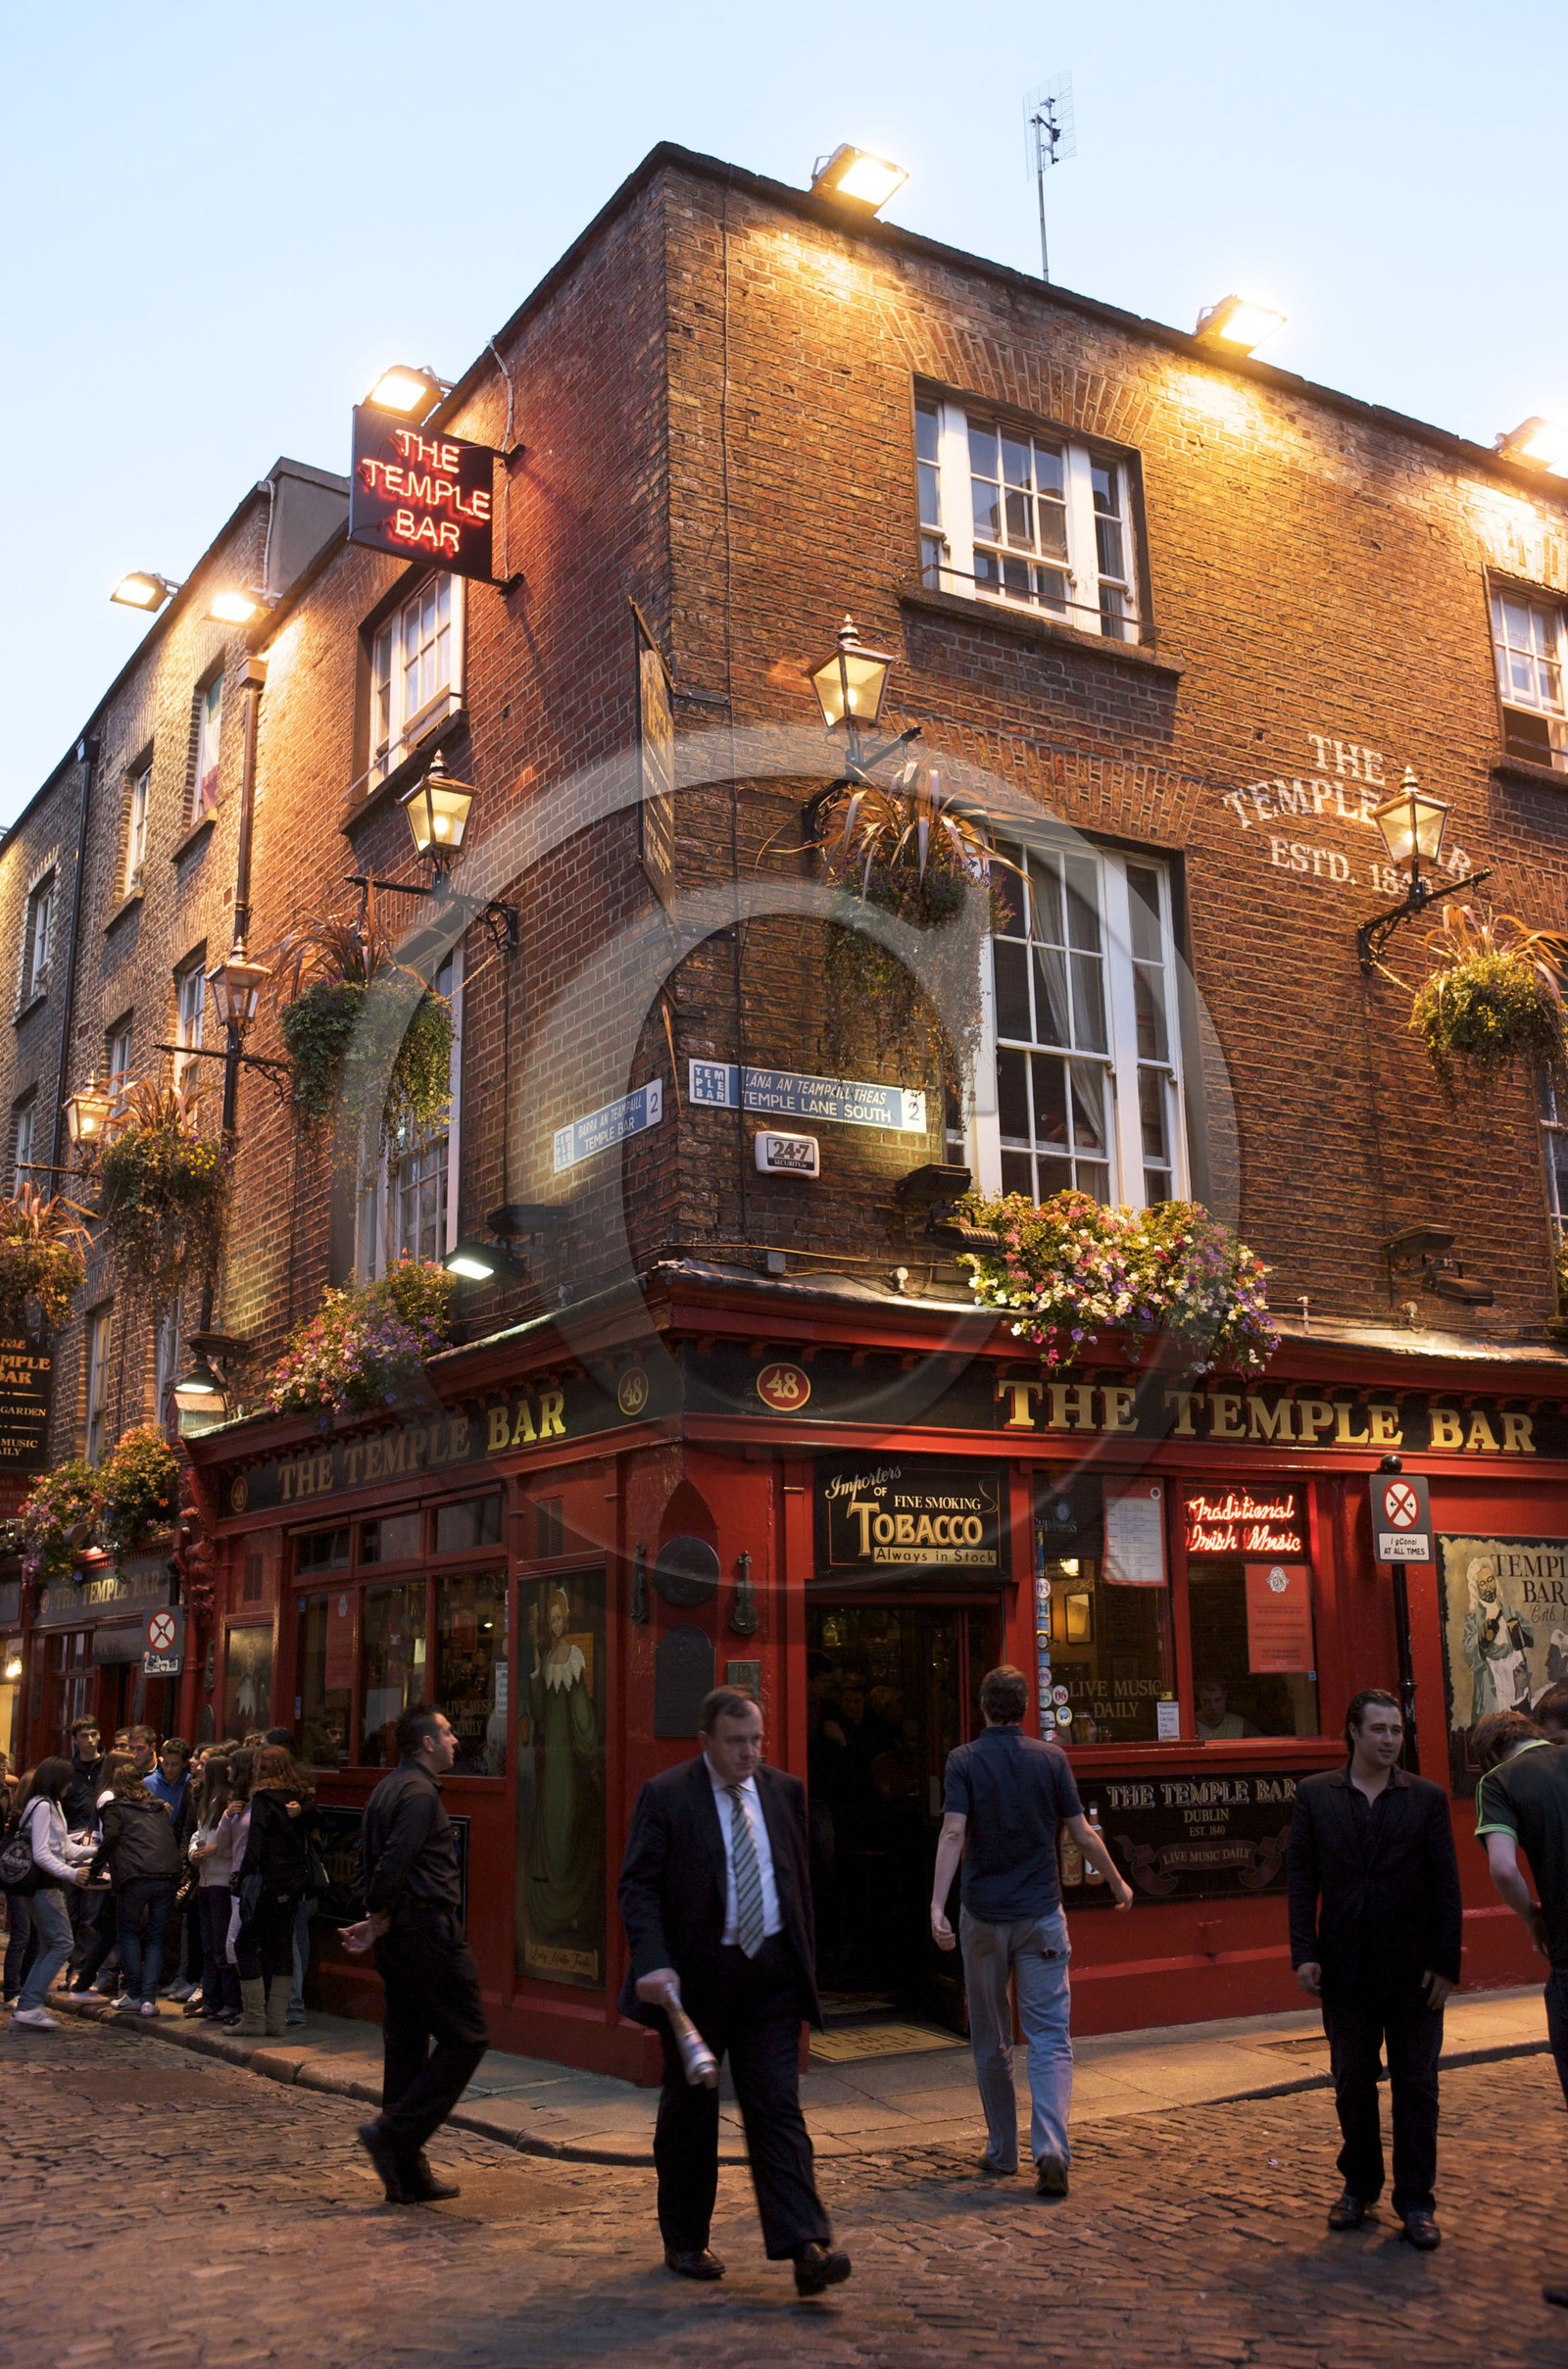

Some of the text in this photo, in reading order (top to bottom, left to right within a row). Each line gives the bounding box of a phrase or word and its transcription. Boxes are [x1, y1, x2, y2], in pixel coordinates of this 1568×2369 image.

[395, 428, 460, 473] THE
[362, 458, 491, 520] TEMPLE
[395, 508, 460, 553] BAR
[1309, 734, 1386, 785] THE
[1221, 778, 1381, 828] TEMPLE
[1269, 836, 1357, 885] ESTD.
[650, 1092, 659, 1114] 2
[696, 1087, 725, 1102] BAR
[776, 1078, 793, 1092] AN
[854, 1088, 887, 1106] THEAS
[742, 1090, 892, 1123] TEMPLE LANE SOUTH
[907, 1101, 920, 1121] 2
[584, 1116, 635, 1153] TEMPLE BAR
[622, 1376, 643, 1407] 48
[766, 1367, 800, 1400] 48
[998, 1379, 1536, 1453] THE TEMPLE BAR
[1, 1438, 39, 1449] MUSIC
[277, 1390, 566, 1502] THE TEMPLE BAR
[824, 1465, 902, 1501] Importers
[873, 1486, 888, 1498] OF
[894, 1495, 981, 1510] FINE SMOKING
[1189, 1495, 1295, 1521] Traditional
[1189, 1524, 1301, 1552] Irish Music
[1394, 1547, 1405, 1555] ALL
[875, 1548, 995, 1564] Always in Stock
[81, 1578, 128, 1606] TEMPLE
[1521, 1579, 1568, 1607] BAR
[1067, 1679, 1162, 1698] LIVE MUSIC
[1093, 1702, 1140, 1719] DAILY
[1106, 1778, 1297, 1808] THE TEMPLE BAR
[1183, 1807, 1229, 1824] DUBLIN
[1189, 1825, 1226, 1838] EST. 1840
[1162, 1848, 1251, 1865] LIVE MUSIC DAILY
